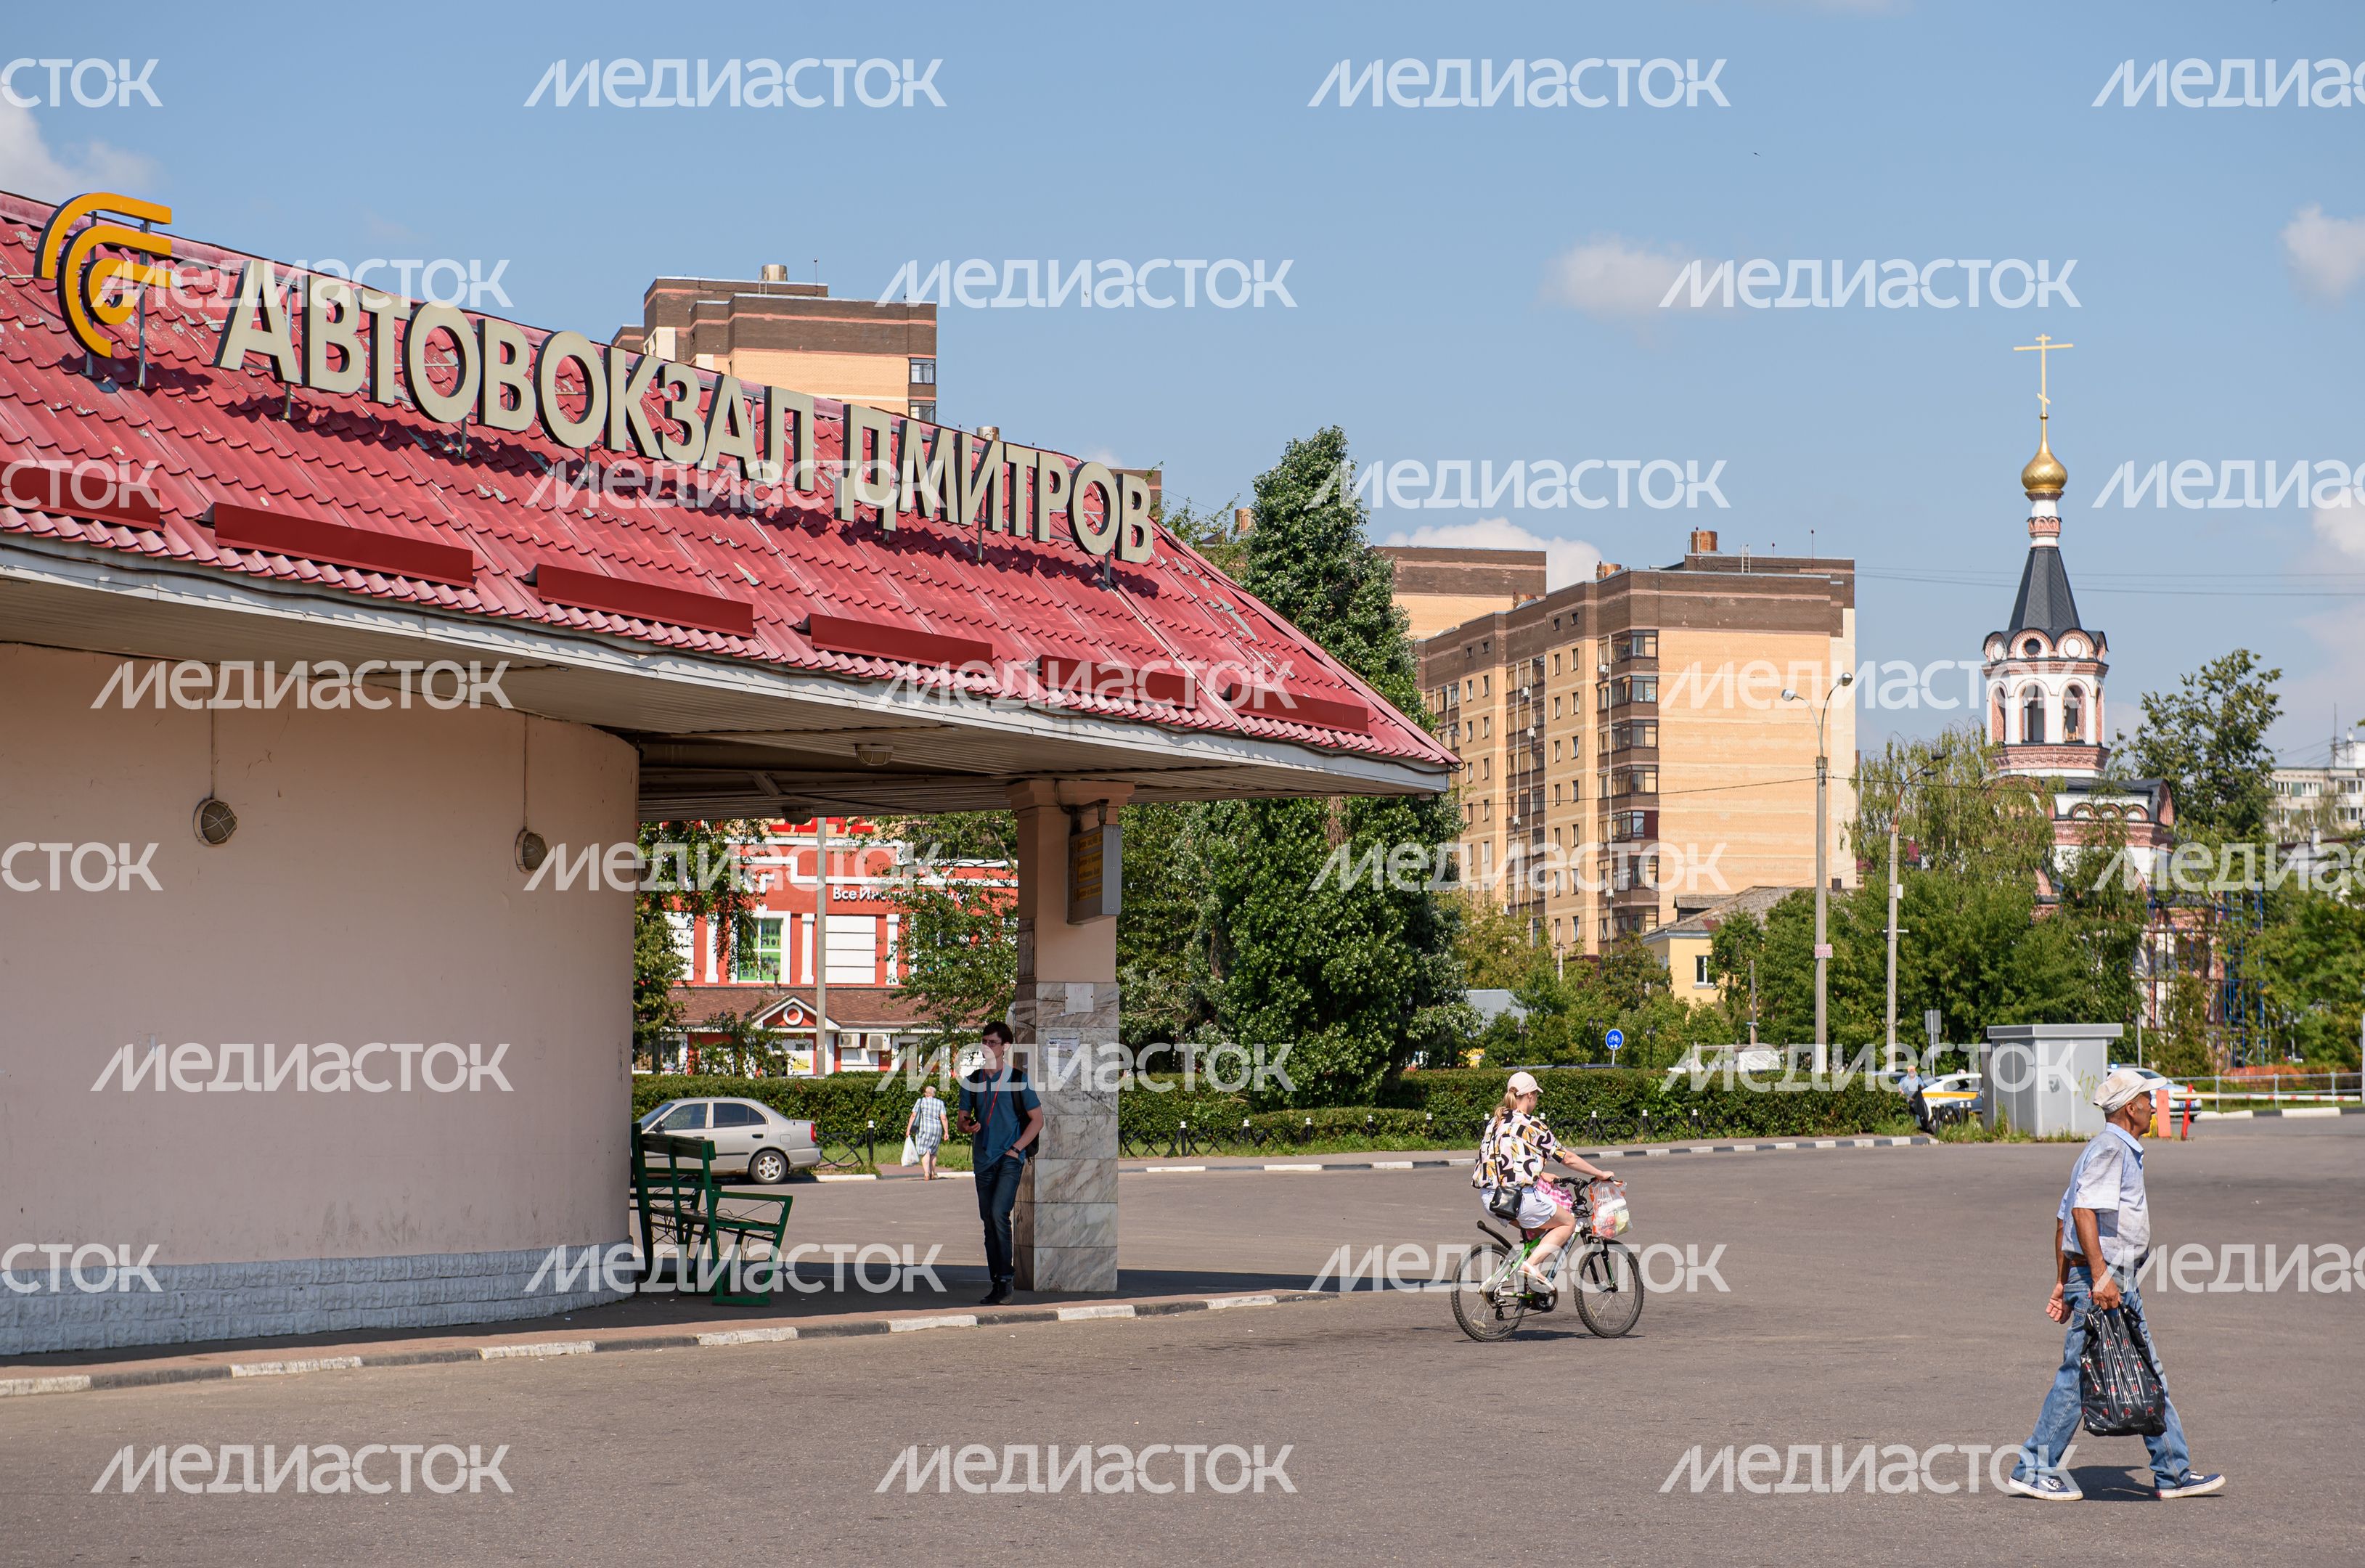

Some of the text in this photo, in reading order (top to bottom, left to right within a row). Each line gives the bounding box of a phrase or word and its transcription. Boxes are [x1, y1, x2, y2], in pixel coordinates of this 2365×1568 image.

[213, 259, 1154, 563] АВТОВОКЗАЛ ДМИТРОВ
[833, 887, 856, 900] Все
